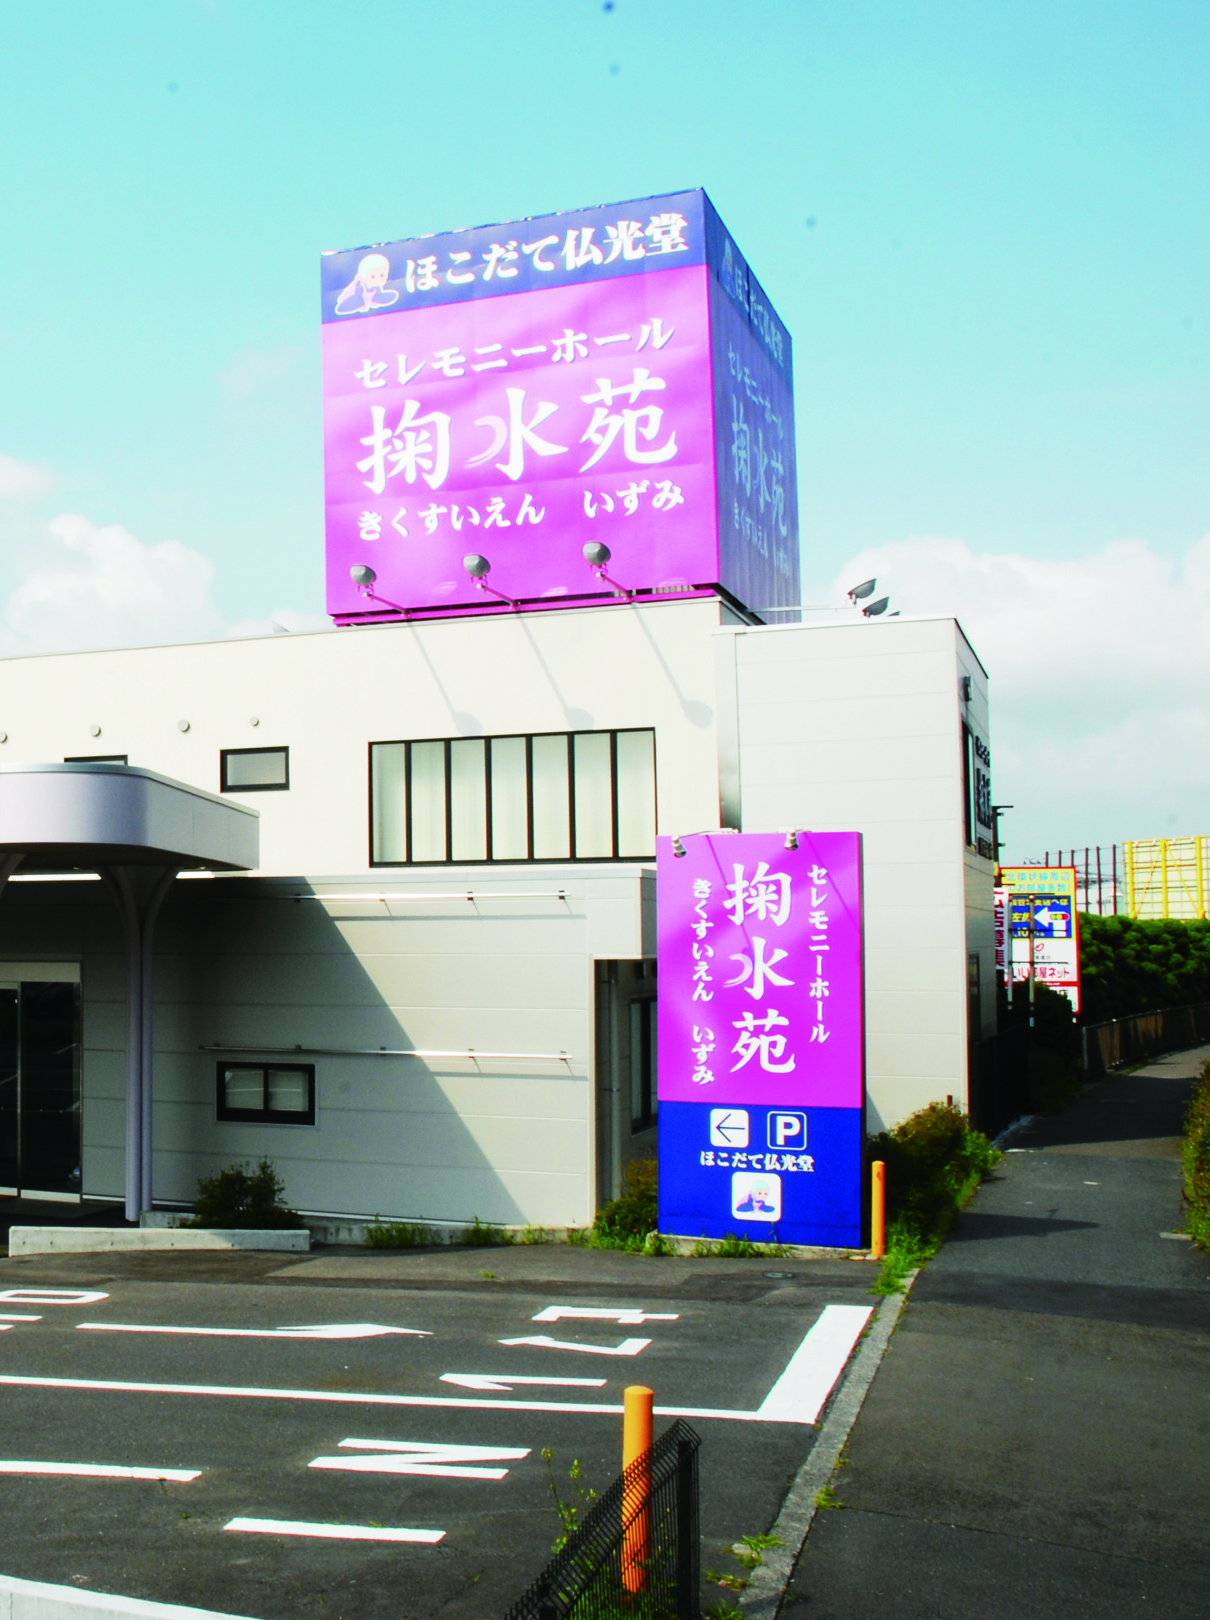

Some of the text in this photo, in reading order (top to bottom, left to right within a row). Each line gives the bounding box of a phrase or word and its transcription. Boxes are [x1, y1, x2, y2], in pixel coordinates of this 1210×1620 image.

[404, 212, 689, 294] ほこだて仏光堂
[353, 318, 676, 389] セレモニーホール
[356, 368, 679, 495] 掬水苑
[358, 479, 685, 541] きくすいえん いずみ
[691, 878, 716, 1085] きくすいえん いずみ
[722, 861, 796, 1073] 掬水苑
[807, 864, 831, 1044] セレモニーホール
[700, 1150, 815, 1173] ほこだて仏光堂
[775, 1115, 801, 1146] P
